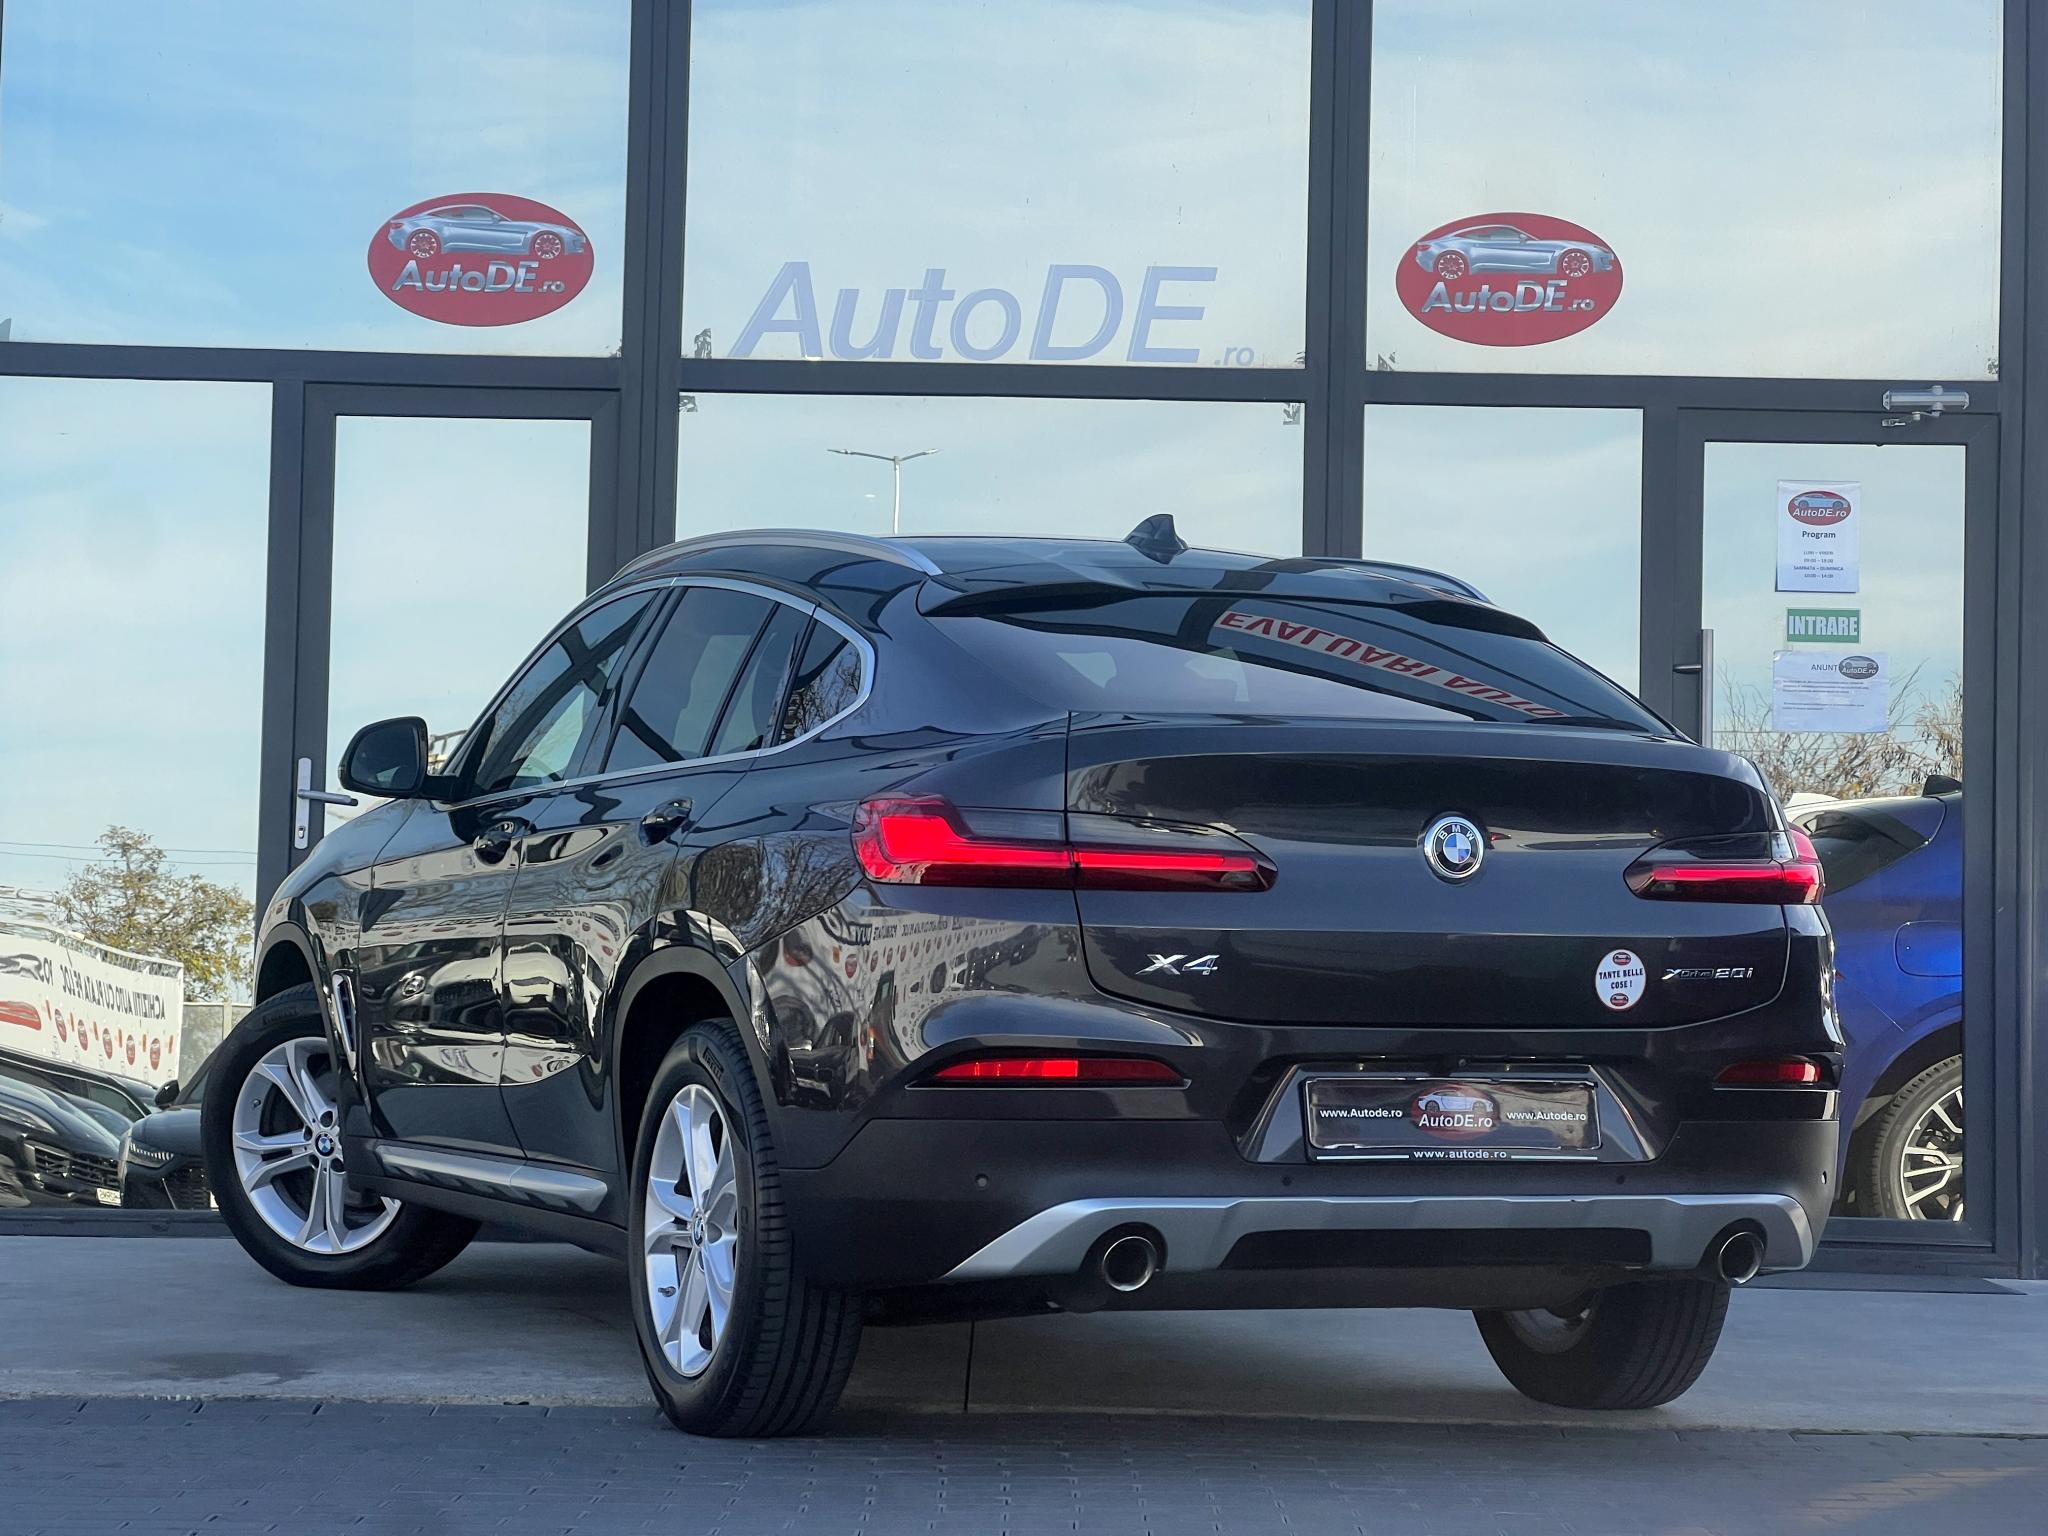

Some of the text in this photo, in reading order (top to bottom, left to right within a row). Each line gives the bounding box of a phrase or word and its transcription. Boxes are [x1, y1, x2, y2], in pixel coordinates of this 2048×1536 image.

[1792, 508, 1847, 517] AutoDE.ro
[1802, 530, 1836, 540] Program
[1788, 615, 1858, 636] INTRARE
[1438, 824, 1475, 841] BMW
[1135, 954, 1220, 976] X4
[1599, 967, 1644, 980] TANTE BELLE
[1611, 980, 1628, 989] COSE
[1319, 1107, 1403, 1119] www.Autode.ro
[1506, 1109, 1587, 1122] www.Autode.ro
[1418, 1113, 1493, 1128] AutoDE.ro
[1413, 1149, 1507, 1159] www.autode.ro
